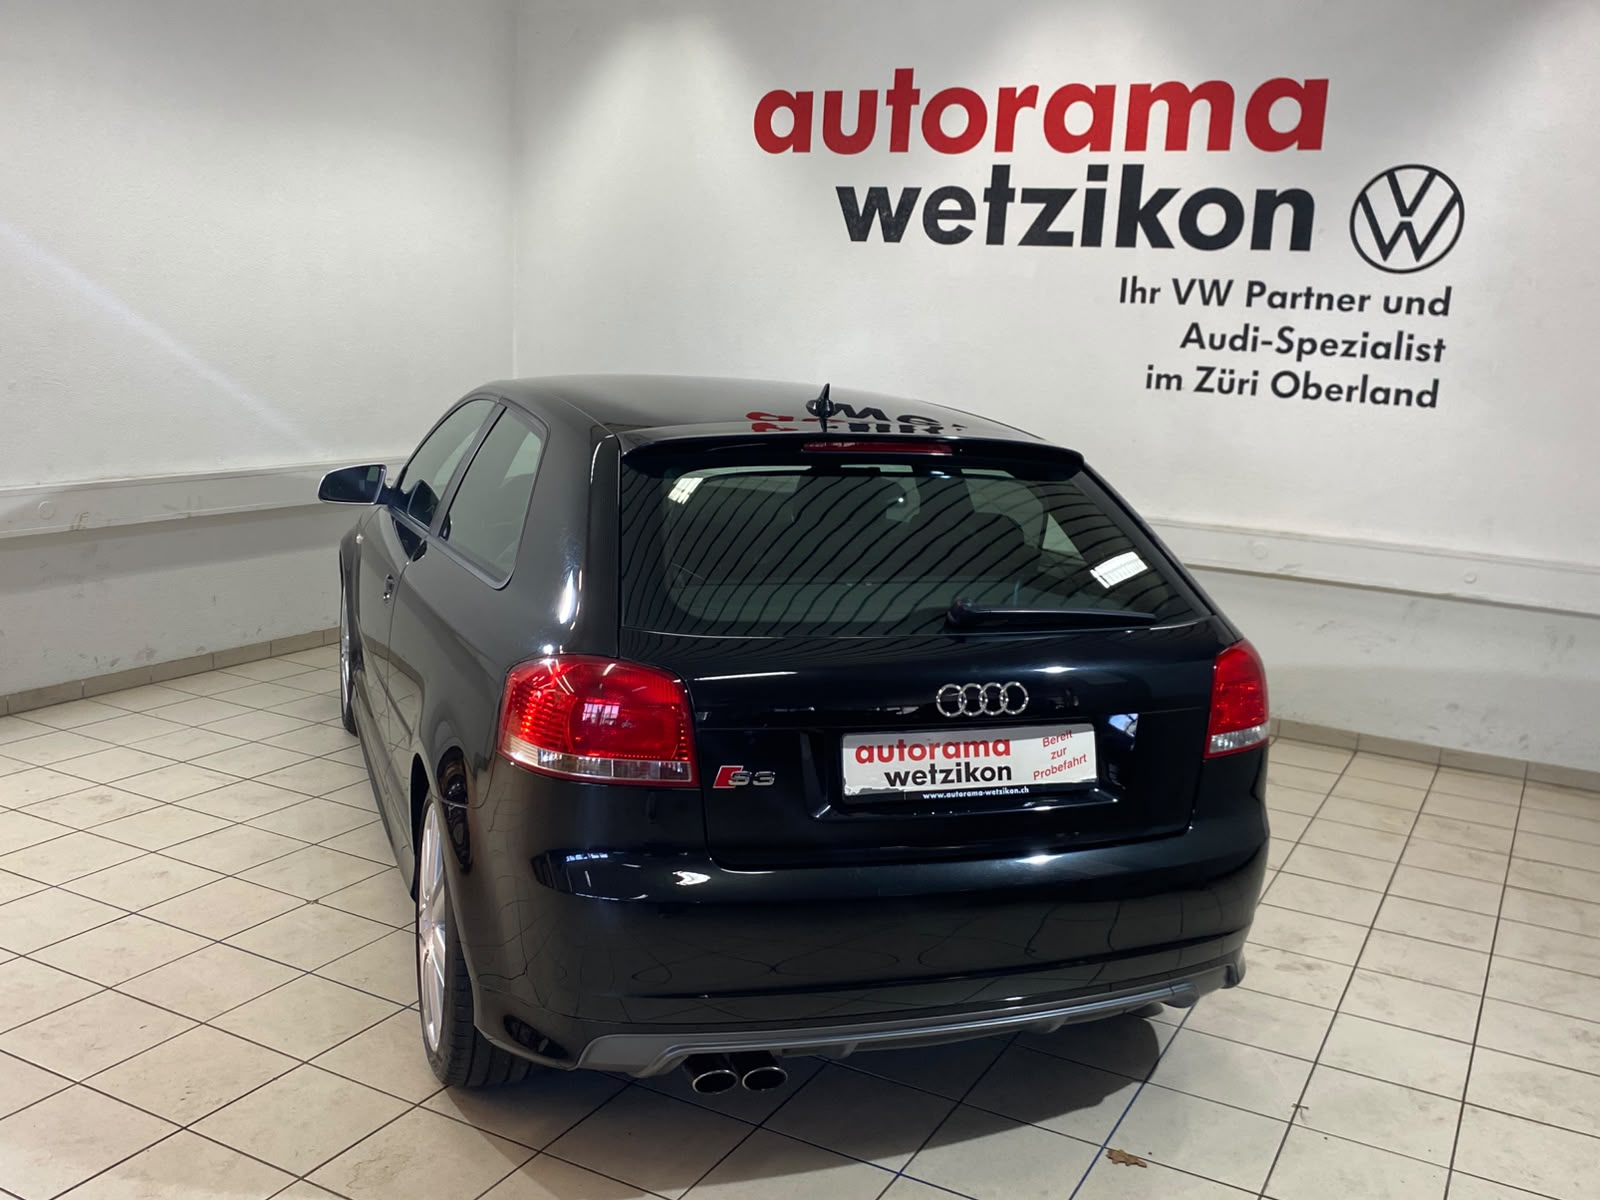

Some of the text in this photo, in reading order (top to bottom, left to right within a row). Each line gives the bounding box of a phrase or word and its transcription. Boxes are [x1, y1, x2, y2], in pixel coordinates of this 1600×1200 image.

[754, 68, 1329, 154] autorama
[836, 164, 1315, 252] wetzikon
[1354, 168, 1463, 270] VW
[1119, 275, 1452, 316] Ihr VW Partner und
[1180, 322, 1446, 363] Audi-Spezialist
[1146, 364, 1440, 408] im Züri Oberland
[855, 738, 1012, 765] autorama
[1042, 729, 1074, 748] Bereit
[1050, 746, 1068, 760] zur
[728, 770, 776, 787] S3
[884, 761, 1013, 787] wetzikon
[1033, 754, 1088, 781] Probefahrt
[922, 786, 1030, 800] www.autorama-wetzikon.ch
